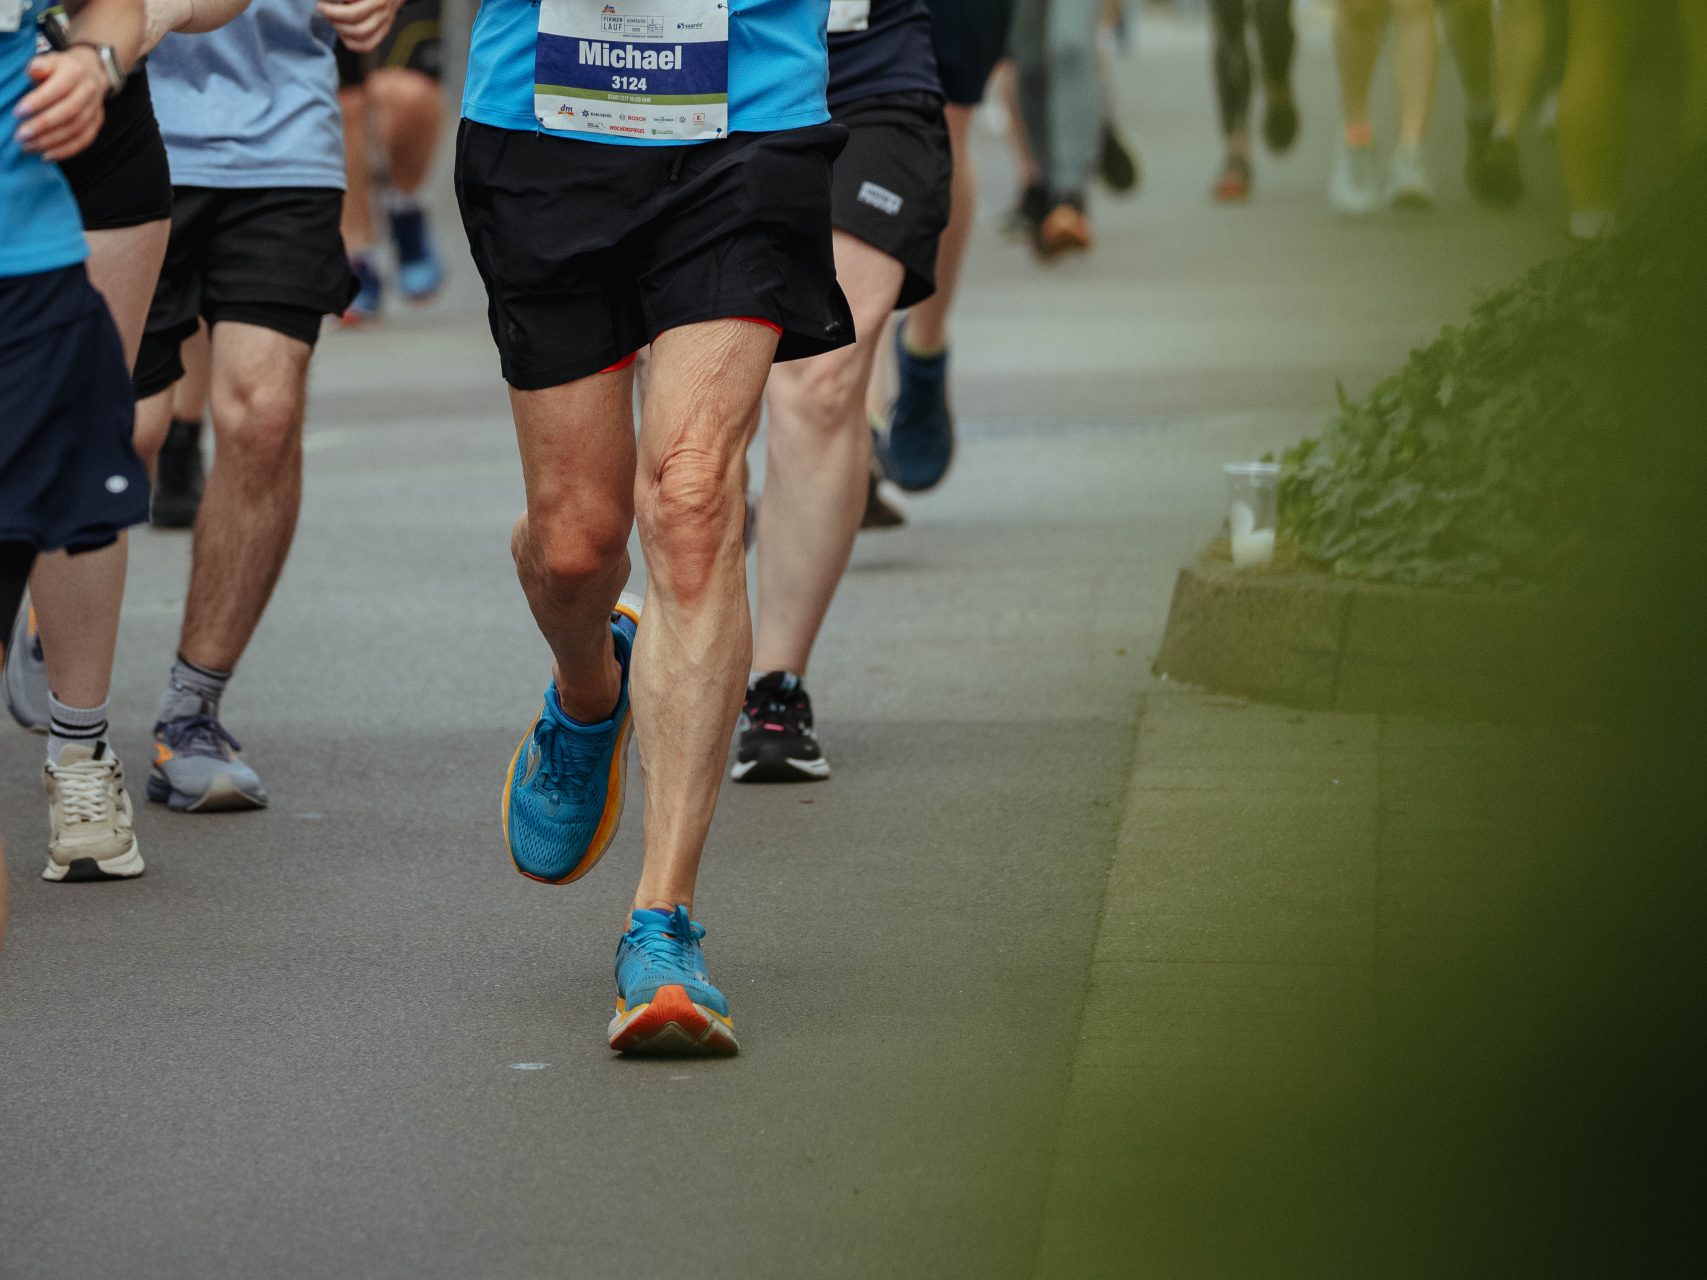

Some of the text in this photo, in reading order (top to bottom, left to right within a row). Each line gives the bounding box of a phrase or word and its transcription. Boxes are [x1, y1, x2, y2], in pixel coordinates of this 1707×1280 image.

[603, 23, 622, 31] LAUF
[578, 40, 682, 70] Michael
[611, 75, 647, 91] 3124
[560, 104, 573, 112] dm
[609, 124, 645, 134] WOCHENSPIEGEL
